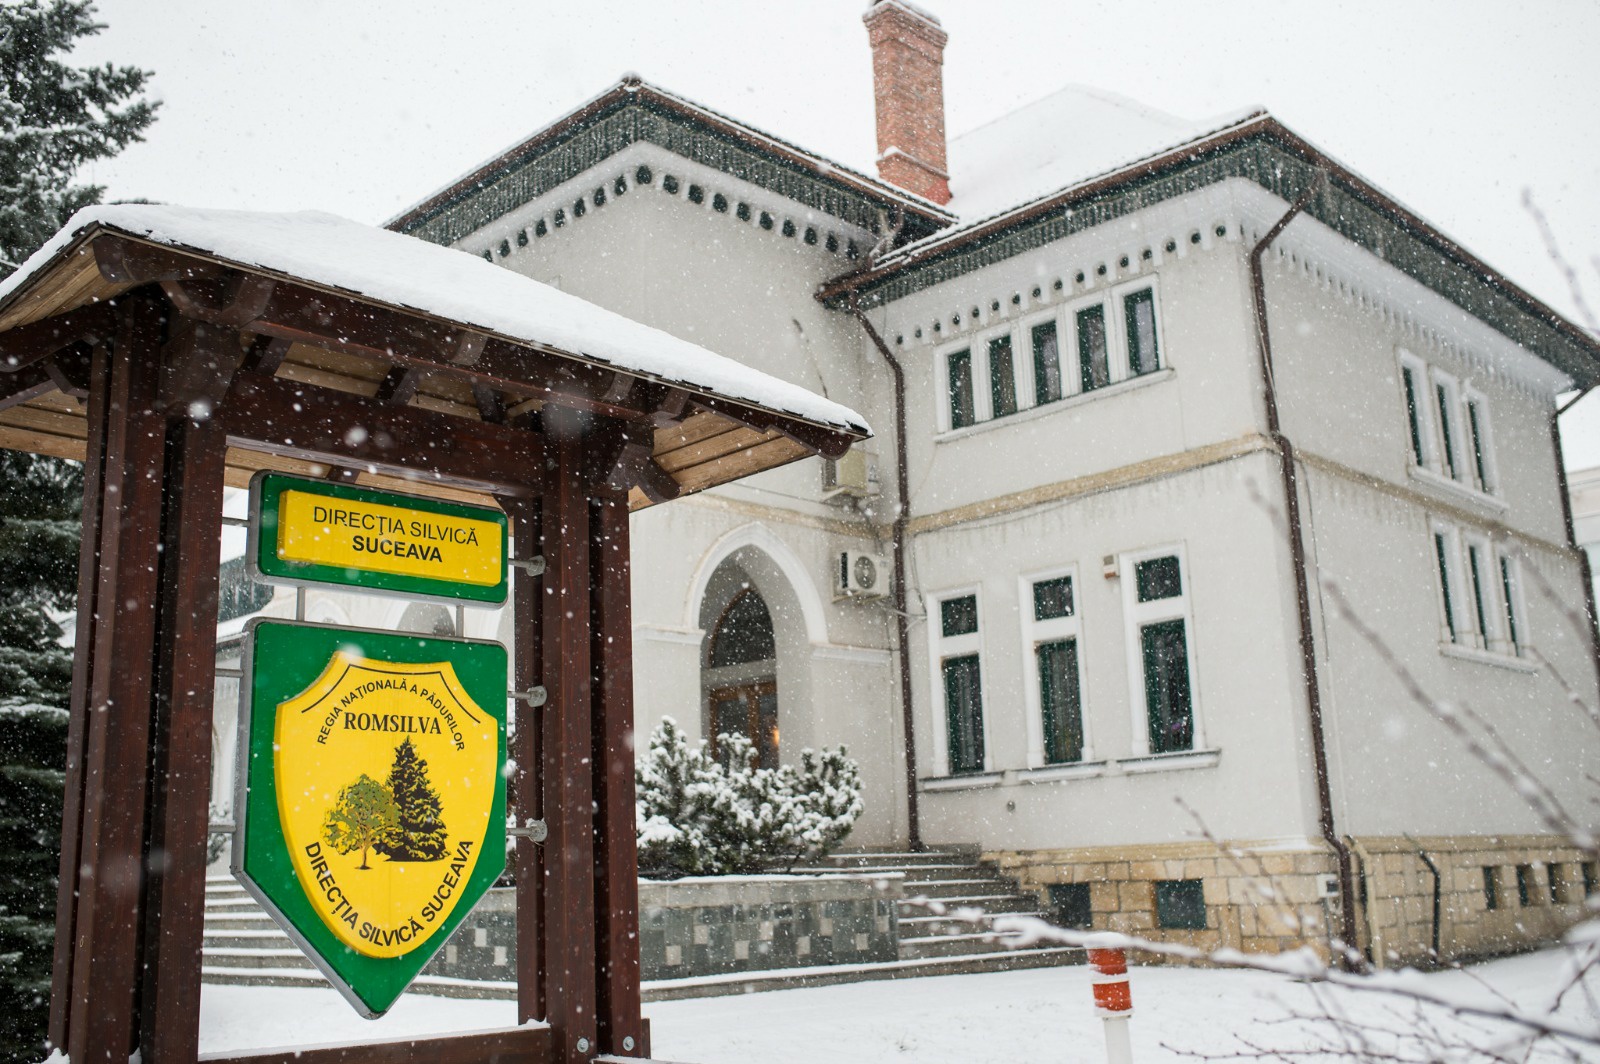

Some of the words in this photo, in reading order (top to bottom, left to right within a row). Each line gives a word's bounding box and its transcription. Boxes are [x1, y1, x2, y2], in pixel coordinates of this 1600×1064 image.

[410, 521, 479, 546] SILVICĂ
[352, 535, 443, 563] SUCEAVA
[317, 704, 343, 745] REGIA
[409, 683, 419, 695] A
[419, 688, 465, 751] PĂDURILOR
[343, 711, 442, 735] ROMSILVA
[358, 916, 425, 947] SILVICĂ
[421, 840, 474, 923] SUCEAVA
